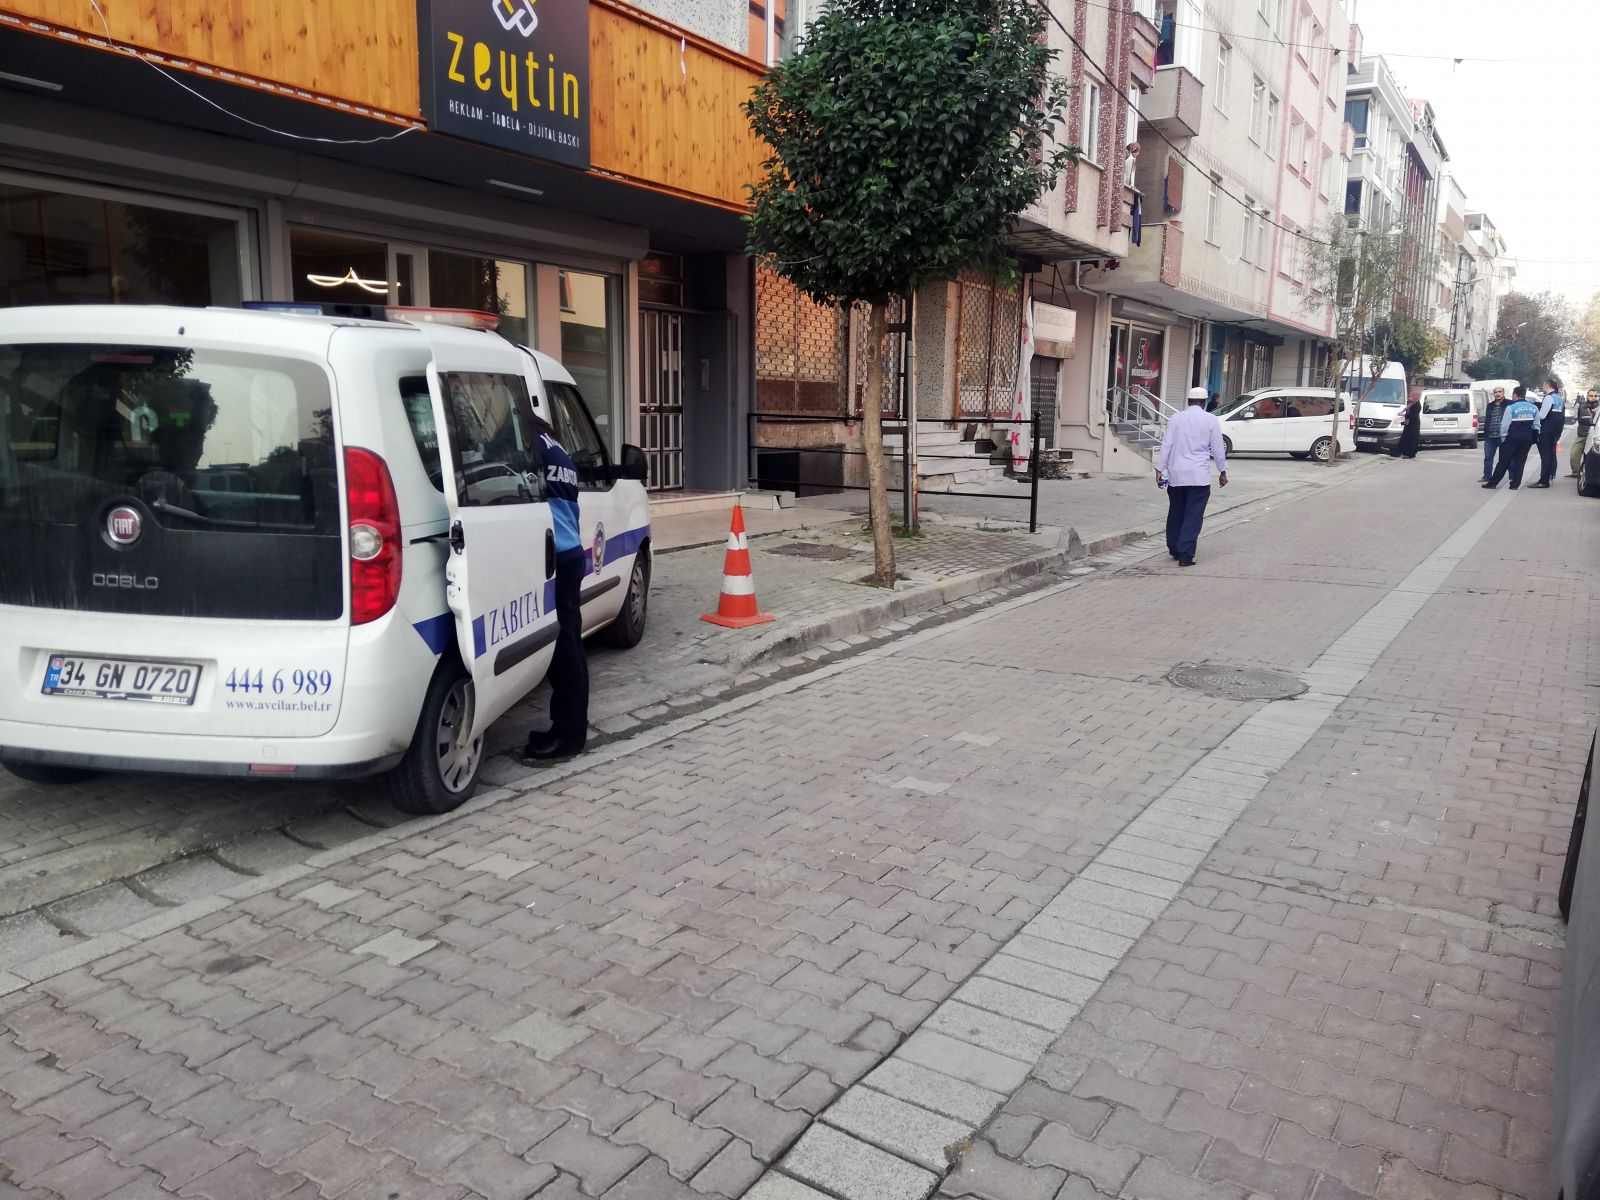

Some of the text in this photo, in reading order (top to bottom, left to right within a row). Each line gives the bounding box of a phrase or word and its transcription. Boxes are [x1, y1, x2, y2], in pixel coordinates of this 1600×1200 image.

[447, 31, 579, 119] Zeytin
[449, 98, 483, 121] REKLAM
[491, 111, 521, 131] TABELA
[558, 131, 580, 148] BASKI
[112, 517, 133, 535] FIAT
[92, 573, 159, 589] DOBLO
[489, 589, 541, 647] ZABITA
[60, 660, 86, 687] 34
[95, 663, 127, 689] GN
[133, 665, 192, 694] 0720
[225, 666, 332, 696] 444 6 989
